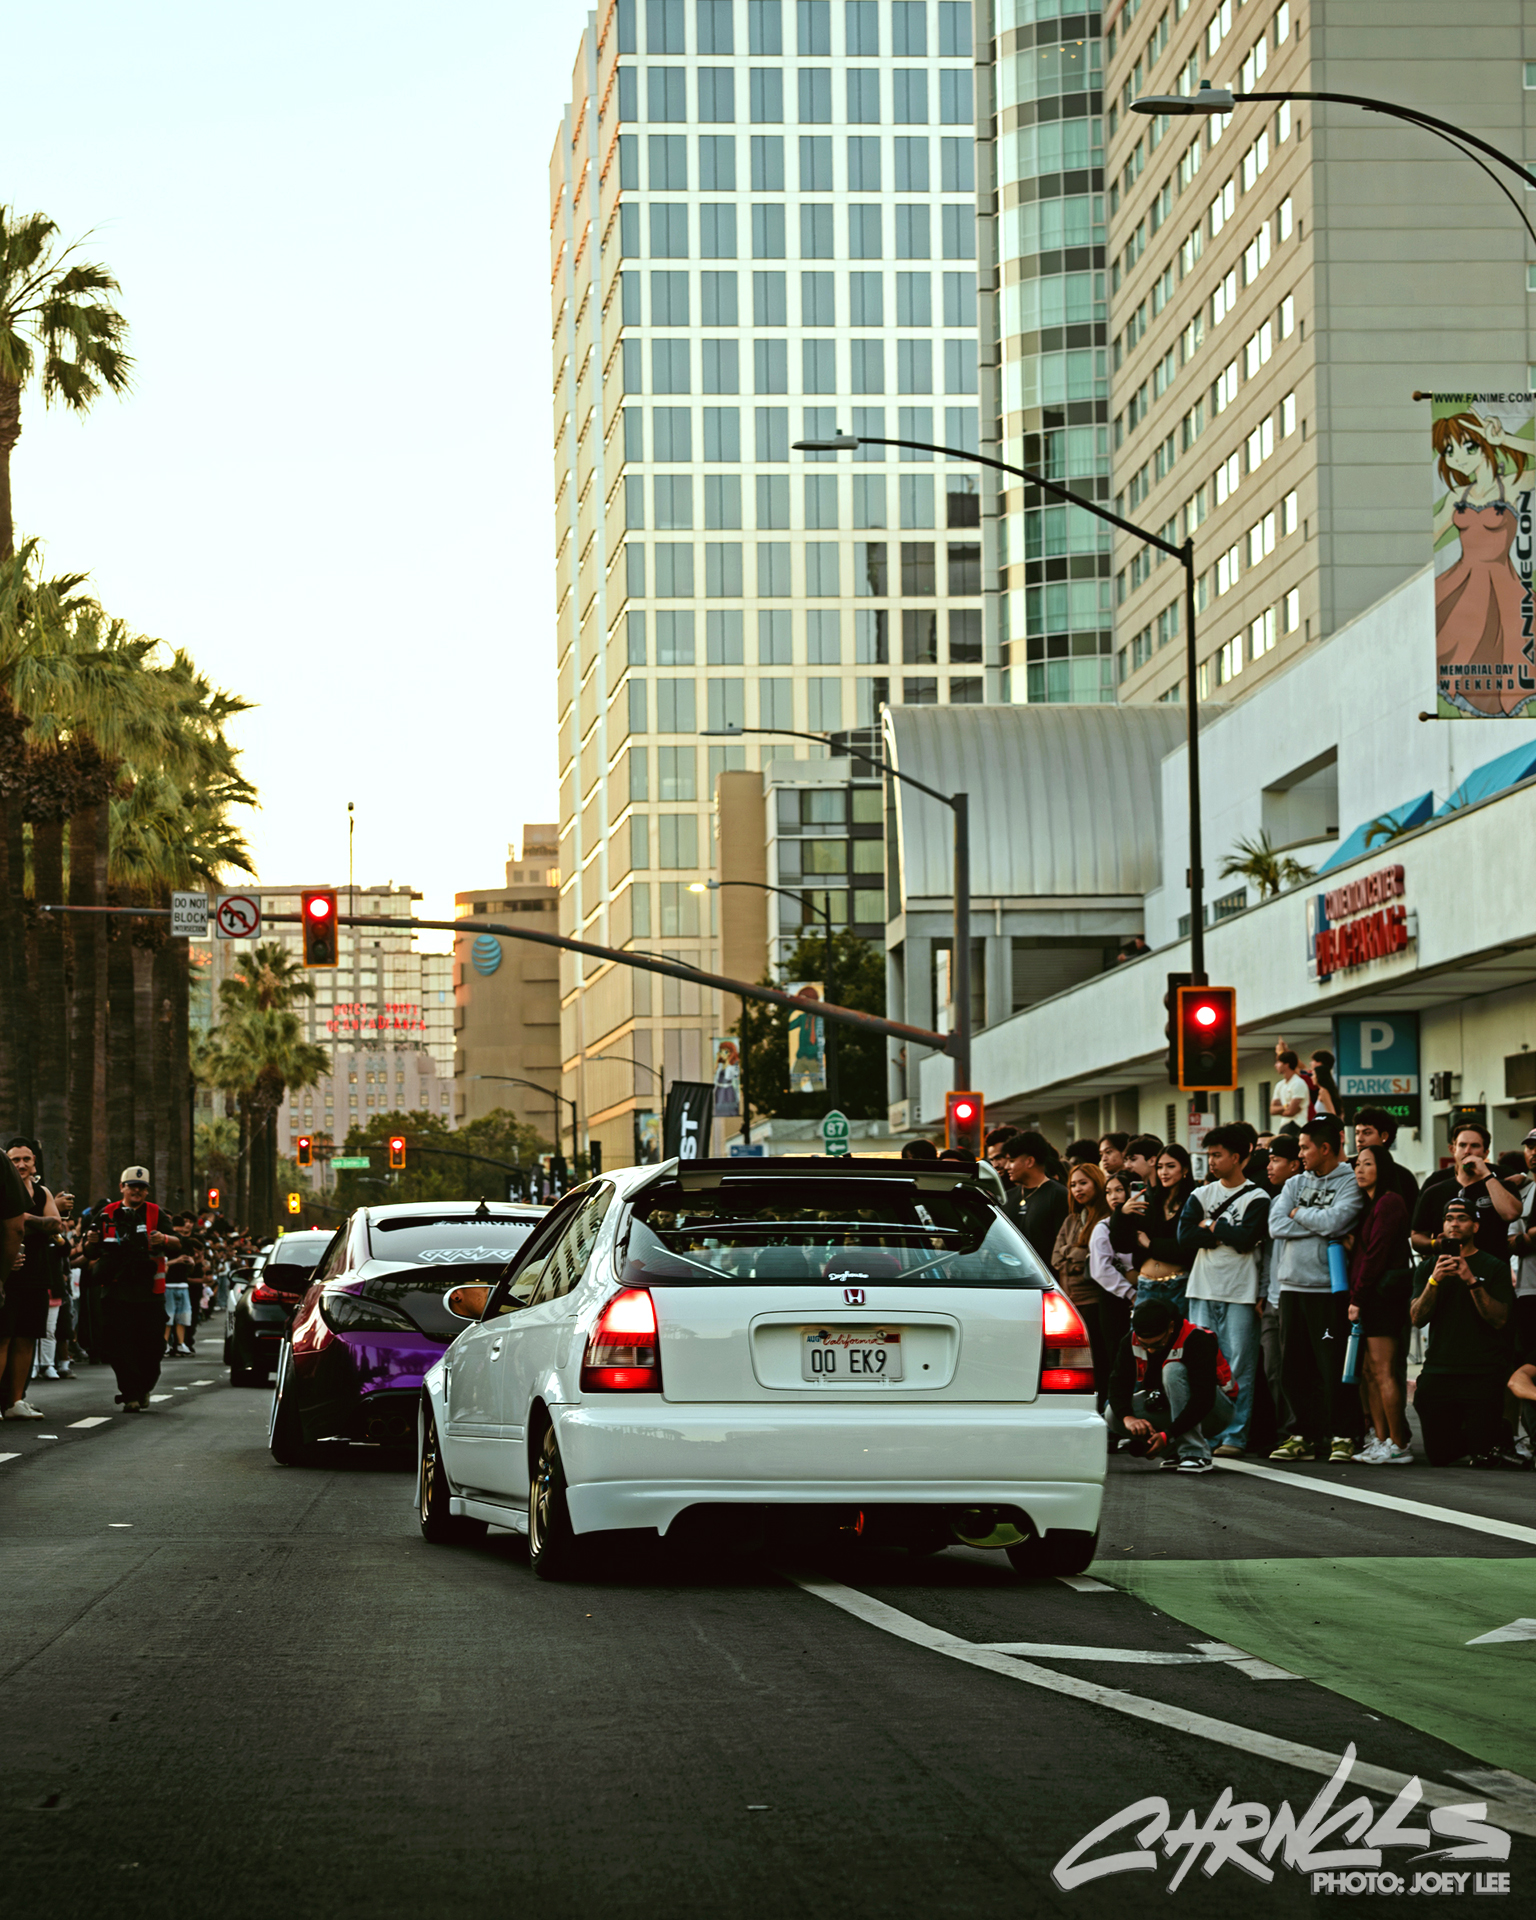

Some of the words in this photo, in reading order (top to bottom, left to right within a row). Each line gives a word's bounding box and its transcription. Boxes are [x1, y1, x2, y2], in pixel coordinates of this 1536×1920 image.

[1434, 393, 1532, 403] WWW.FANIME.COM
[1439, 664, 1494, 676] MEMORIAL
[1495, 664, 1513, 676] DAY
[1440, 678, 1515, 691] WEEKEND
[175, 897, 187, 909] DO
[189, 898, 207, 909] NOT
[174, 912, 207, 923] BLOCK
[1360, 1021, 1395, 1069] P
[826, 1121, 846, 1136] 87
[823, 1333, 884, 1349] California
[849, 1349, 887, 1373] EK9
